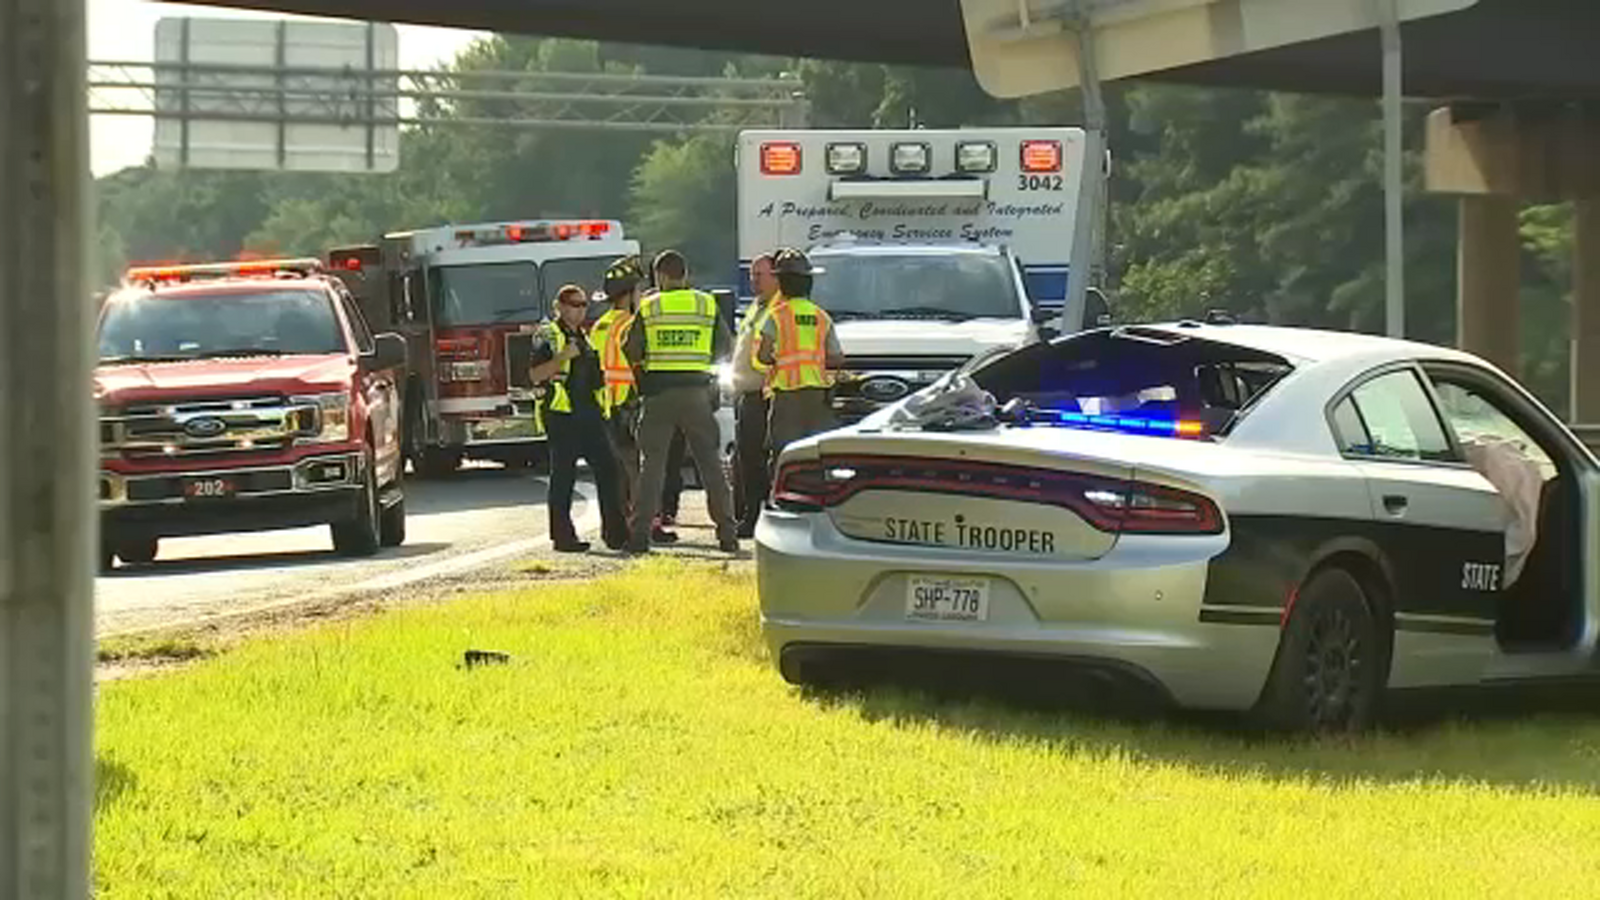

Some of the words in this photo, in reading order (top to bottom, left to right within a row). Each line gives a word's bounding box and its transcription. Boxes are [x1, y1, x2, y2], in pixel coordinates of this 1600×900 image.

[1017, 174, 1063, 191] 3042
[757, 202, 775, 218] A
[952, 203, 981, 216] and
[986, 201, 1064, 219] Integrated
[892, 223, 953, 239] Services
[959, 223, 1014, 242] System
[194, 479, 225, 497] 202
[884, 516, 945, 543] STATE
[956, 524, 1054, 553] TROOPER
[1461, 561, 1500, 591] STATE
[913, 586, 980, 613] SHP-778
